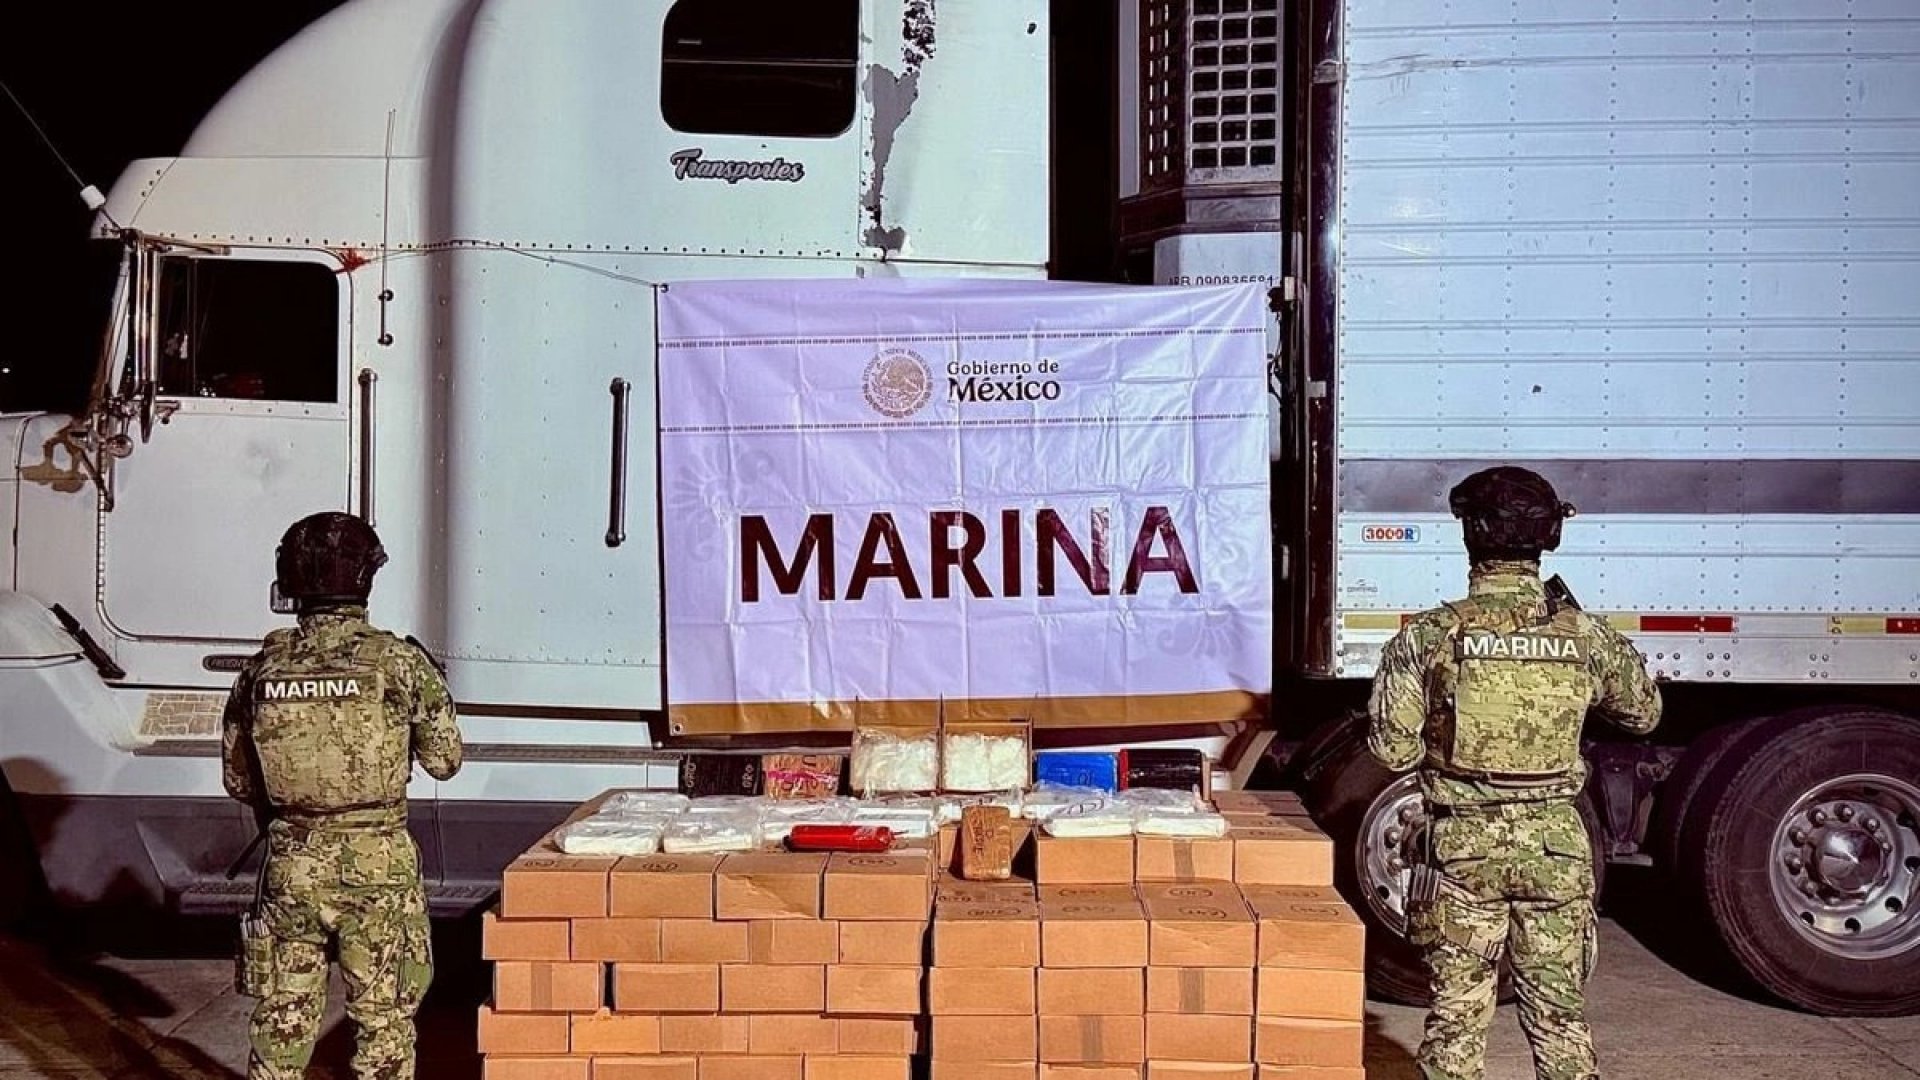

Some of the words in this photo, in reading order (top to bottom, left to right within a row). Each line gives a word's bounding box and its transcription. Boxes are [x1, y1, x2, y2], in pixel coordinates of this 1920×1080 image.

[670, 148, 805, 184] Transportes
[947, 361, 1032, 375] Gobierno
[1038, 359, 1059, 374] de
[947, 375, 1062, 402] México
[1366, 527, 1414, 540] 3000R
[740, 506, 1200, 603] MARINA
[1463, 636, 1579, 658] MARINA
[264, 679, 361, 699] MARINA
